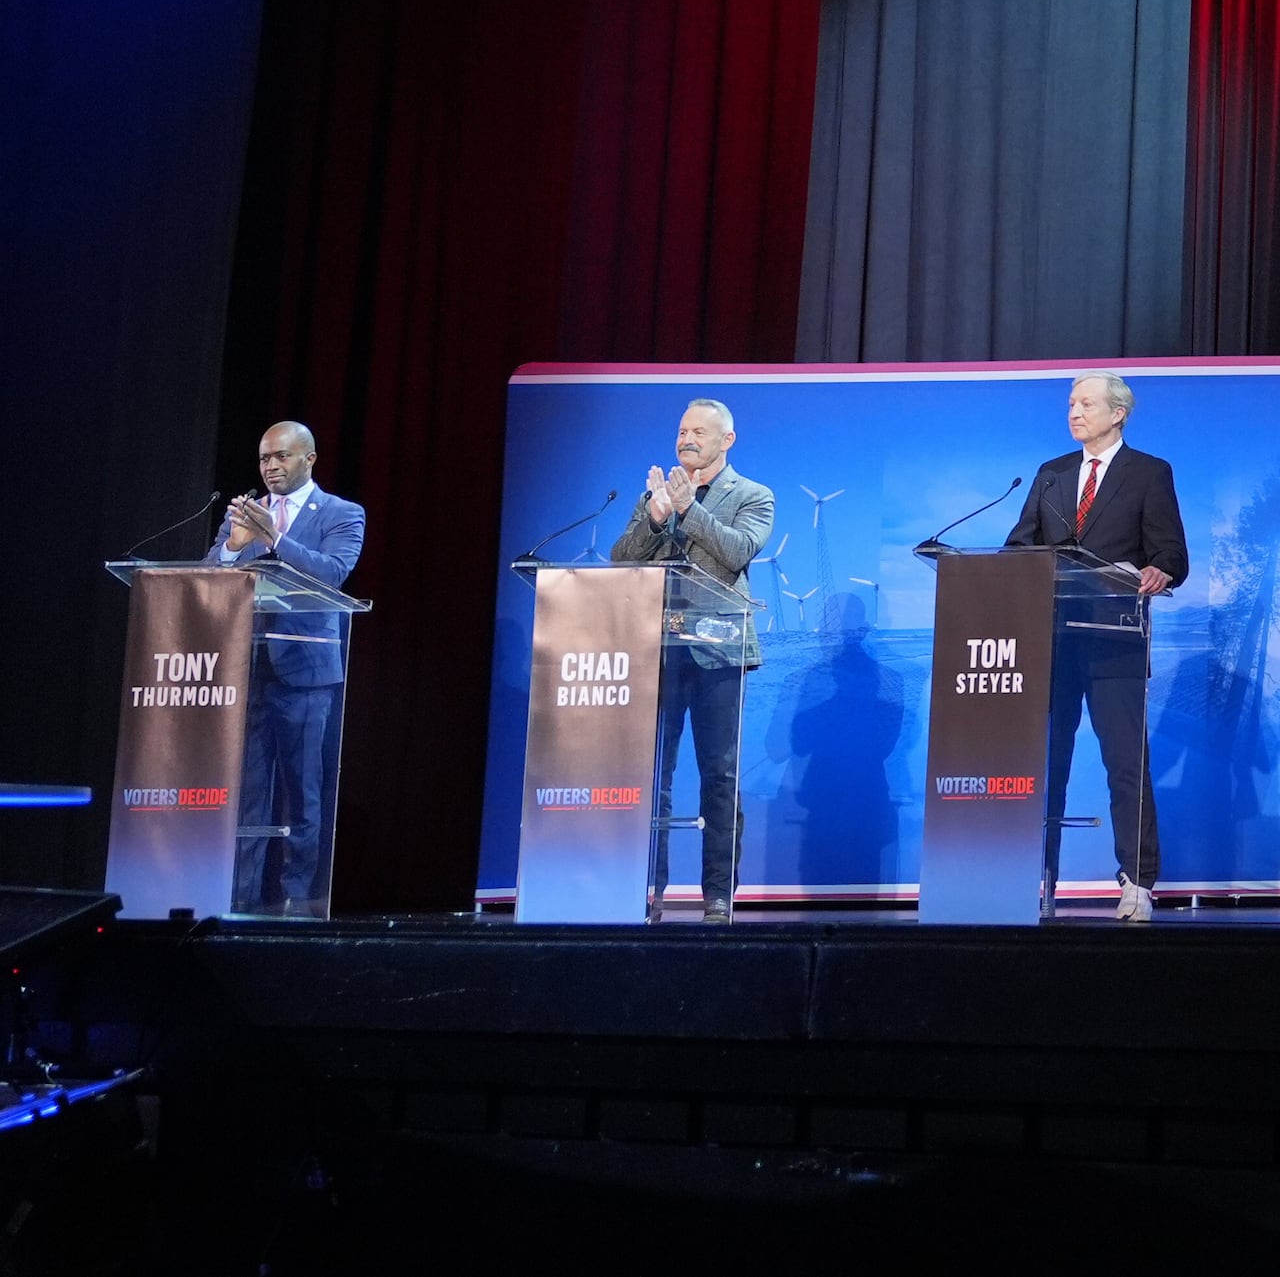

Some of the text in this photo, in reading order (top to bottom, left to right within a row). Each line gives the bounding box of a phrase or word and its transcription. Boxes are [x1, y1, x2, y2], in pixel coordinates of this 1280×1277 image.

[966, 638, 1017, 669] TOM
[153, 652, 220, 682] TONY
[560, 651, 630, 682] CHAD
[955, 672, 1024, 694] STEYER
[131, 685, 237, 707] THURMOND
[556, 684, 631, 707] BIANCO
[935, 775, 1035, 795] VOTERS DECIDE
[122, 787, 229, 806] VOTERS DECIDE
[535, 787, 641, 806] VOTERS DECIDE
